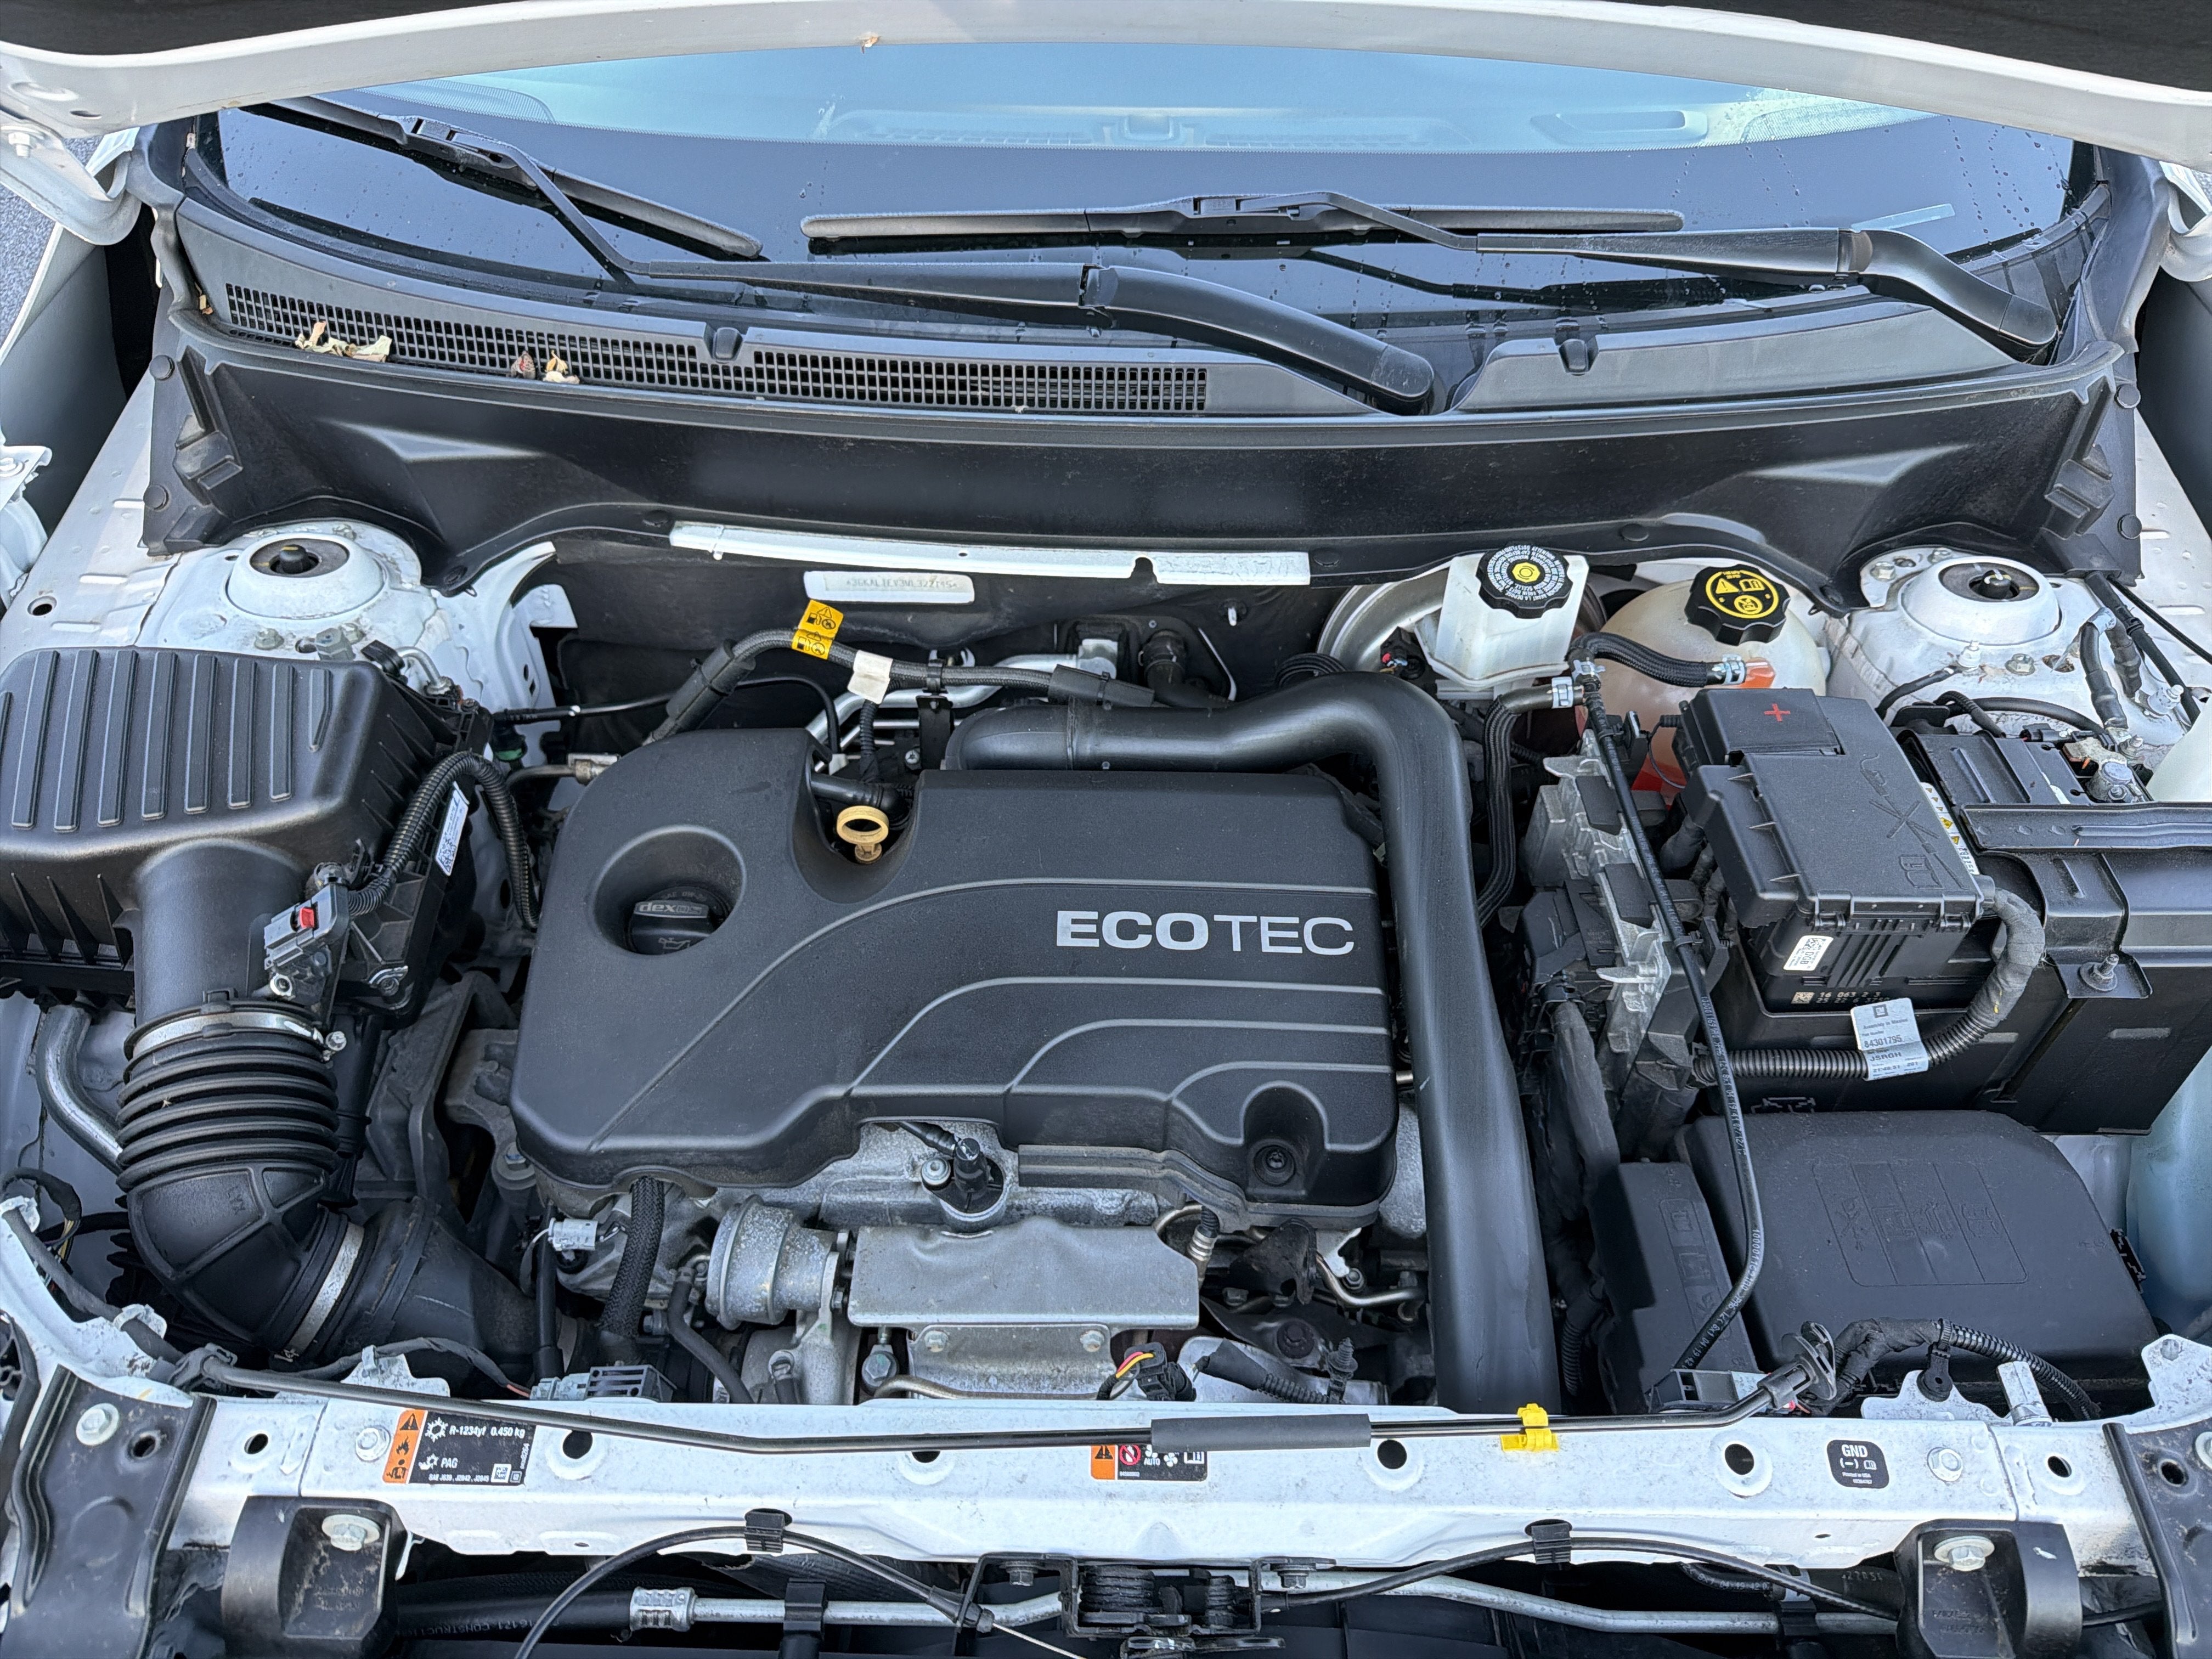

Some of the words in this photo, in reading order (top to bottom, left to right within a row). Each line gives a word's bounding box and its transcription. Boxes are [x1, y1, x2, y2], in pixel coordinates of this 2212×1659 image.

[639, 902, 702, 915] dexos
[1057, 910, 1355, 956] ECOTEC
[449, 1425, 487, 1438] R-1234yf
[490, 1426, 514, 1437] 0.450
[515, 1427, 526, 1439] kg
[1841, 1444, 1868, 1458] GND
[441, 1457, 458, 1469] PAG
[1143, 1458, 1161, 1466] AUTO
